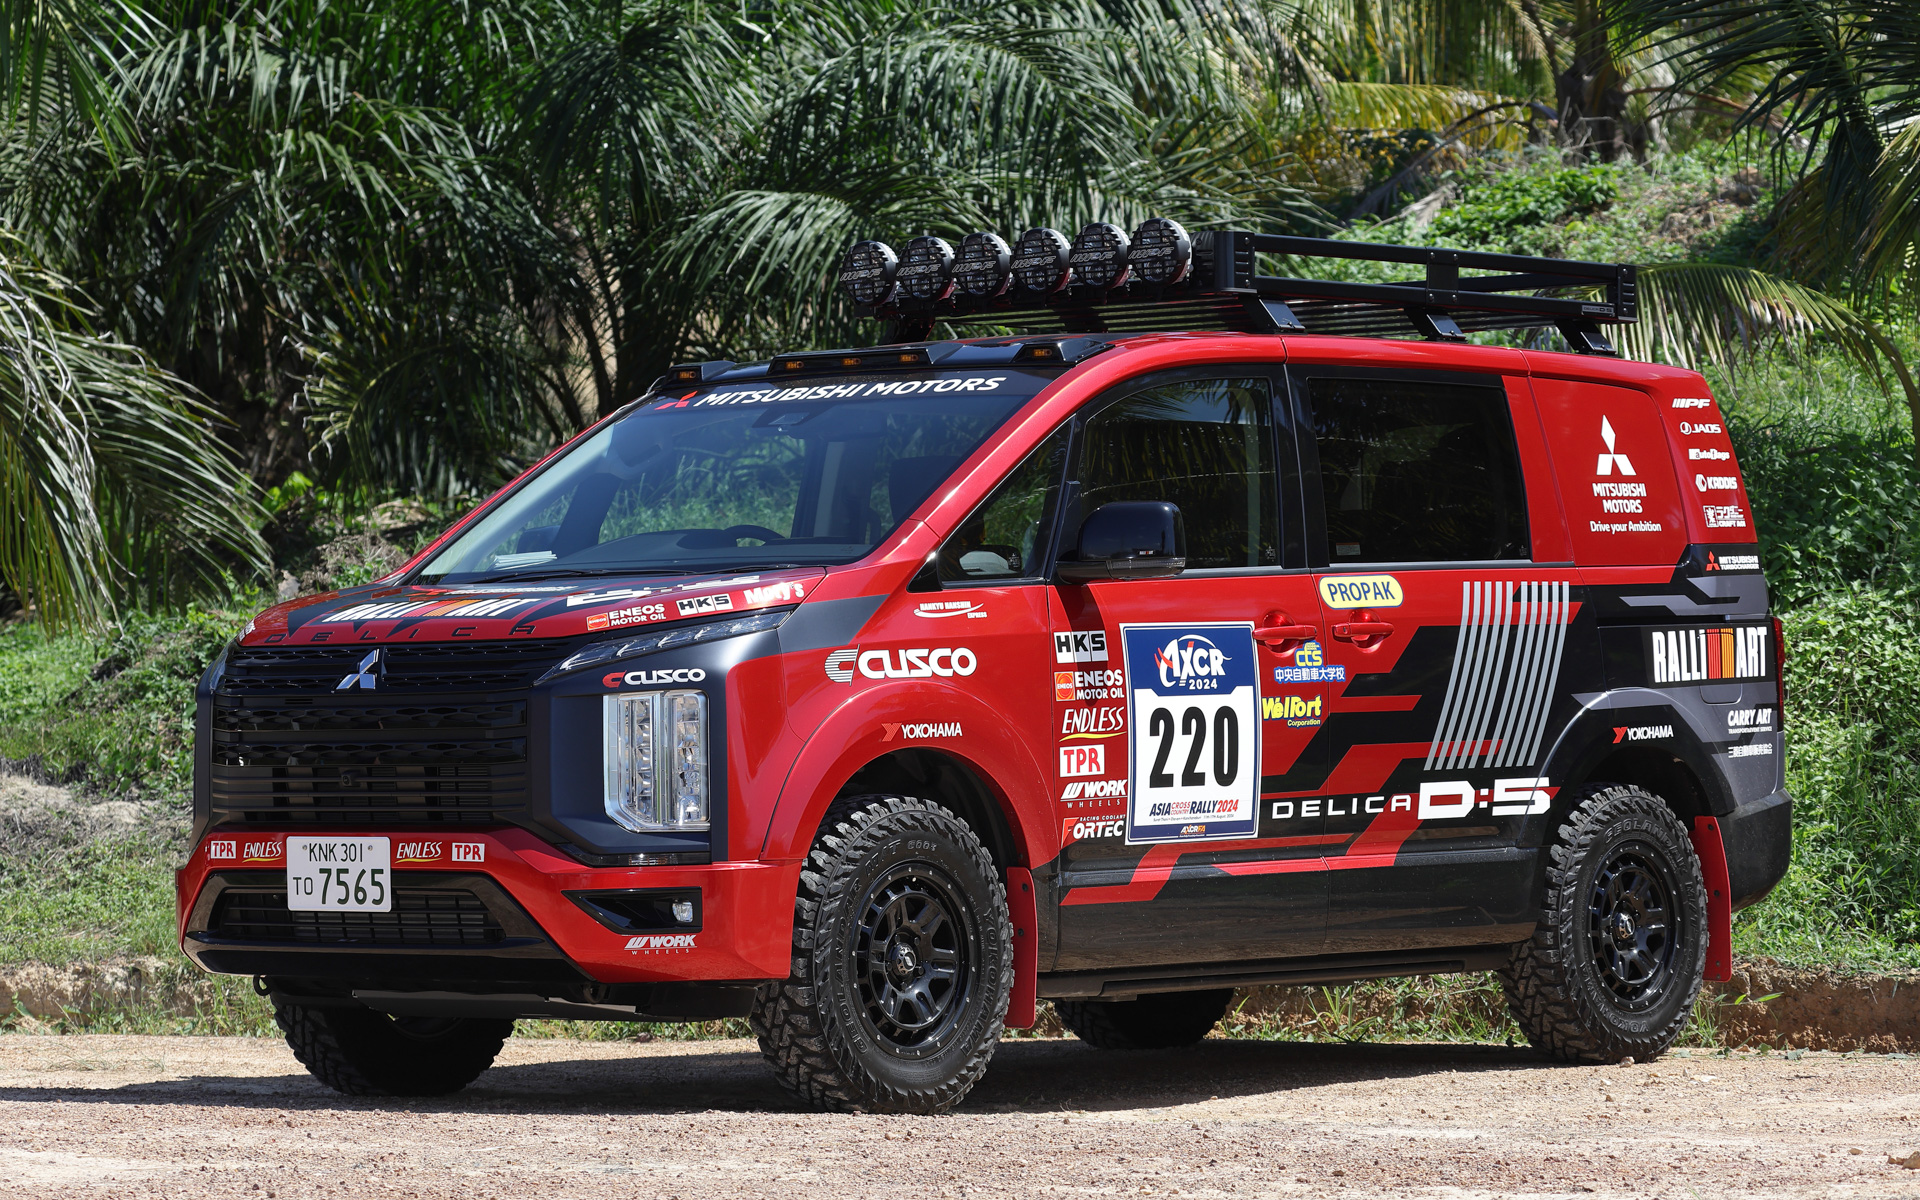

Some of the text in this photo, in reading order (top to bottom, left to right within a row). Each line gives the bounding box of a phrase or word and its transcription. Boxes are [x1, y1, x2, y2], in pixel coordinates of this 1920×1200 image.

[694, 377, 1007, 407] MITSUBISHI MOTORS
[1691, 423, 1721, 434] JAOS
[1592, 483, 1646, 497] MITSUBISHI
[1602, 499, 1642, 513] MOTORS
[1590, 521, 1662, 534] Drive your Ambition
[1327, 582, 1395, 602] PROPAK
[608, 603, 666, 619] ENEOS
[679, 595, 731, 612] HKS
[611, 614, 650, 627] MOTOR
[650, 612, 667, 622] OIL
[264, 624, 538, 643] DELICA
[1055, 633, 1106, 653] HKS
[858, 647, 977, 679] CUSCO
[624, 668, 706, 685] CUSCO
[1074, 669, 1123, 688] ENEOS
[1275, 667, 1345, 681] 中央自動車大学校
[1189, 678, 1218, 690] 2024
[1077, 687, 1124, 700] MOTOR OIL
[1062, 706, 1124, 733] ENDLESS
[1287, 718, 1321, 727] Corporation
[1728, 708, 1772, 726] CARRY ART
[902, 722, 962, 739] YOKOHAMA
[1627, 725, 1674, 741] YOKOHAMA
[1150, 706, 1239, 788] 220
[1064, 748, 1101, 773] TPR
[1084, 779, 1128, 798] WORK
[1067, 799, 1120, 808] WHEELS
[1272, 776, 1551, 820] DELICA D:5
[1149, 799, 1239, 816] ASIA RALLY 2024
[213, 841, 235, 857] TPR
[243, 841, 283, 859] ENDLESS
[309, 843, 363, 863] KNK 301
[396, 842, 443, 860] ENDLESS
[454, 844, 482, 861] TPR
[293, 868, 385, 906] TO 7565
[650, 935, 697, 949] WORK
